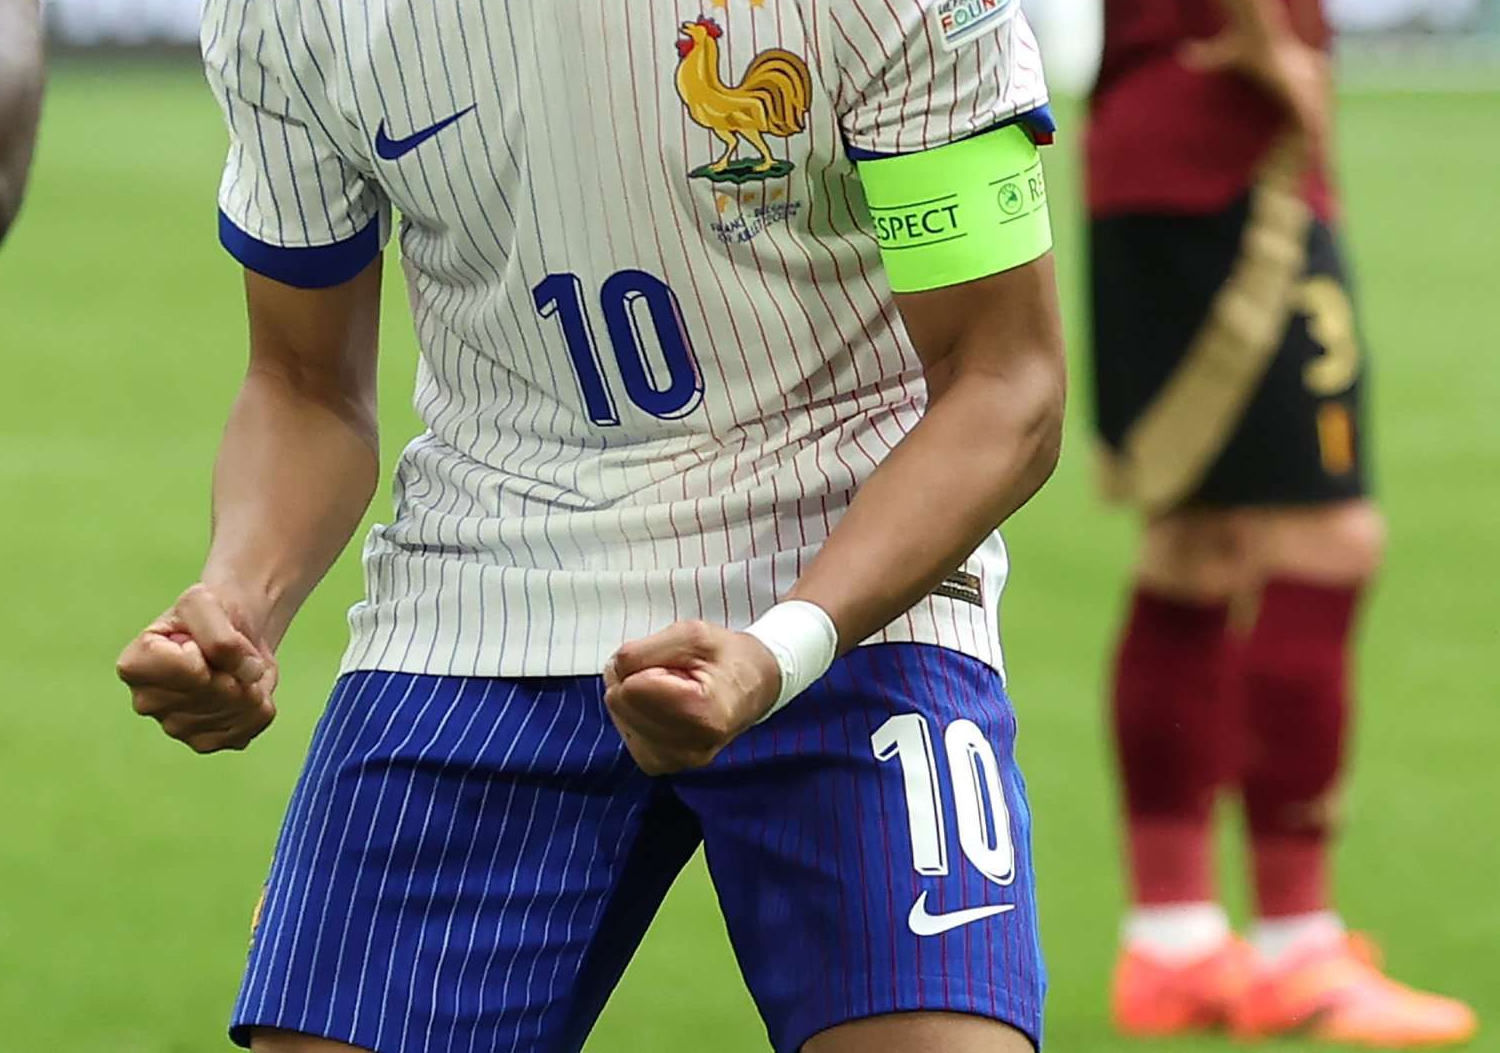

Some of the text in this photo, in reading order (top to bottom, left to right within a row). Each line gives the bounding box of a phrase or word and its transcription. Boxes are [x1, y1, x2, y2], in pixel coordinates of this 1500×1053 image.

[531, 268, 706, 427] 10
[1296, 276, 1361, 397] 3
[870, 712, 1017, 887] 10
